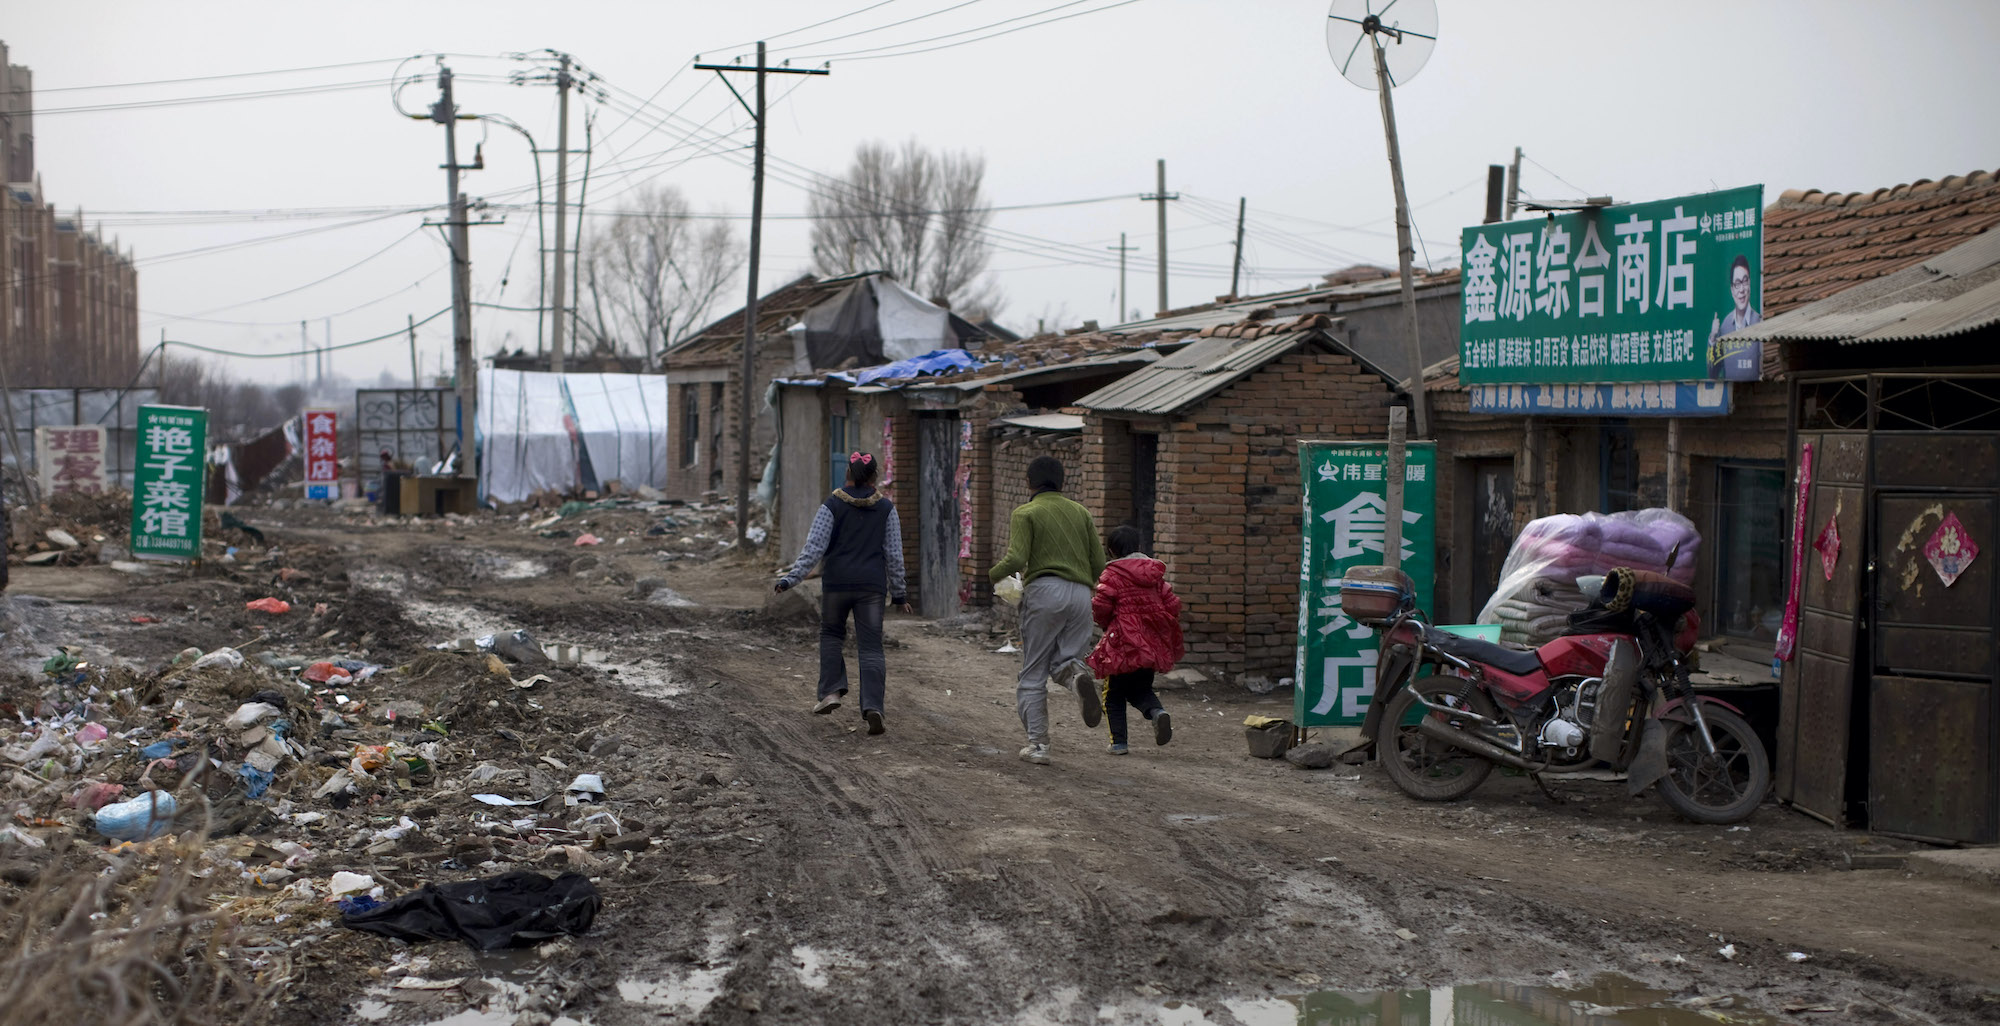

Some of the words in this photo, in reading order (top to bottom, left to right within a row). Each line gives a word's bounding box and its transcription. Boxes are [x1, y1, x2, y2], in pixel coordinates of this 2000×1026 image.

[1713, 208, 1755, 231] 伟星地暖
[1465, 206, 1698, 325] 鑫源综合商店
[1464, 339, 1496, 368] 五金电料
[1534, 335, 1569, 367] 日用百货
[1571, 333, 1608, 367] 食品饮料
[1610, 331, 1650, 365] 烟酒雪糕
[1653, 328, 1694, 363] 充值话吧
[310, 413, 335, 479] 食杂店
[1343, 463, 1426, 481] 伟星暖
[140, 425, 194, 536] 艳子菜馆
